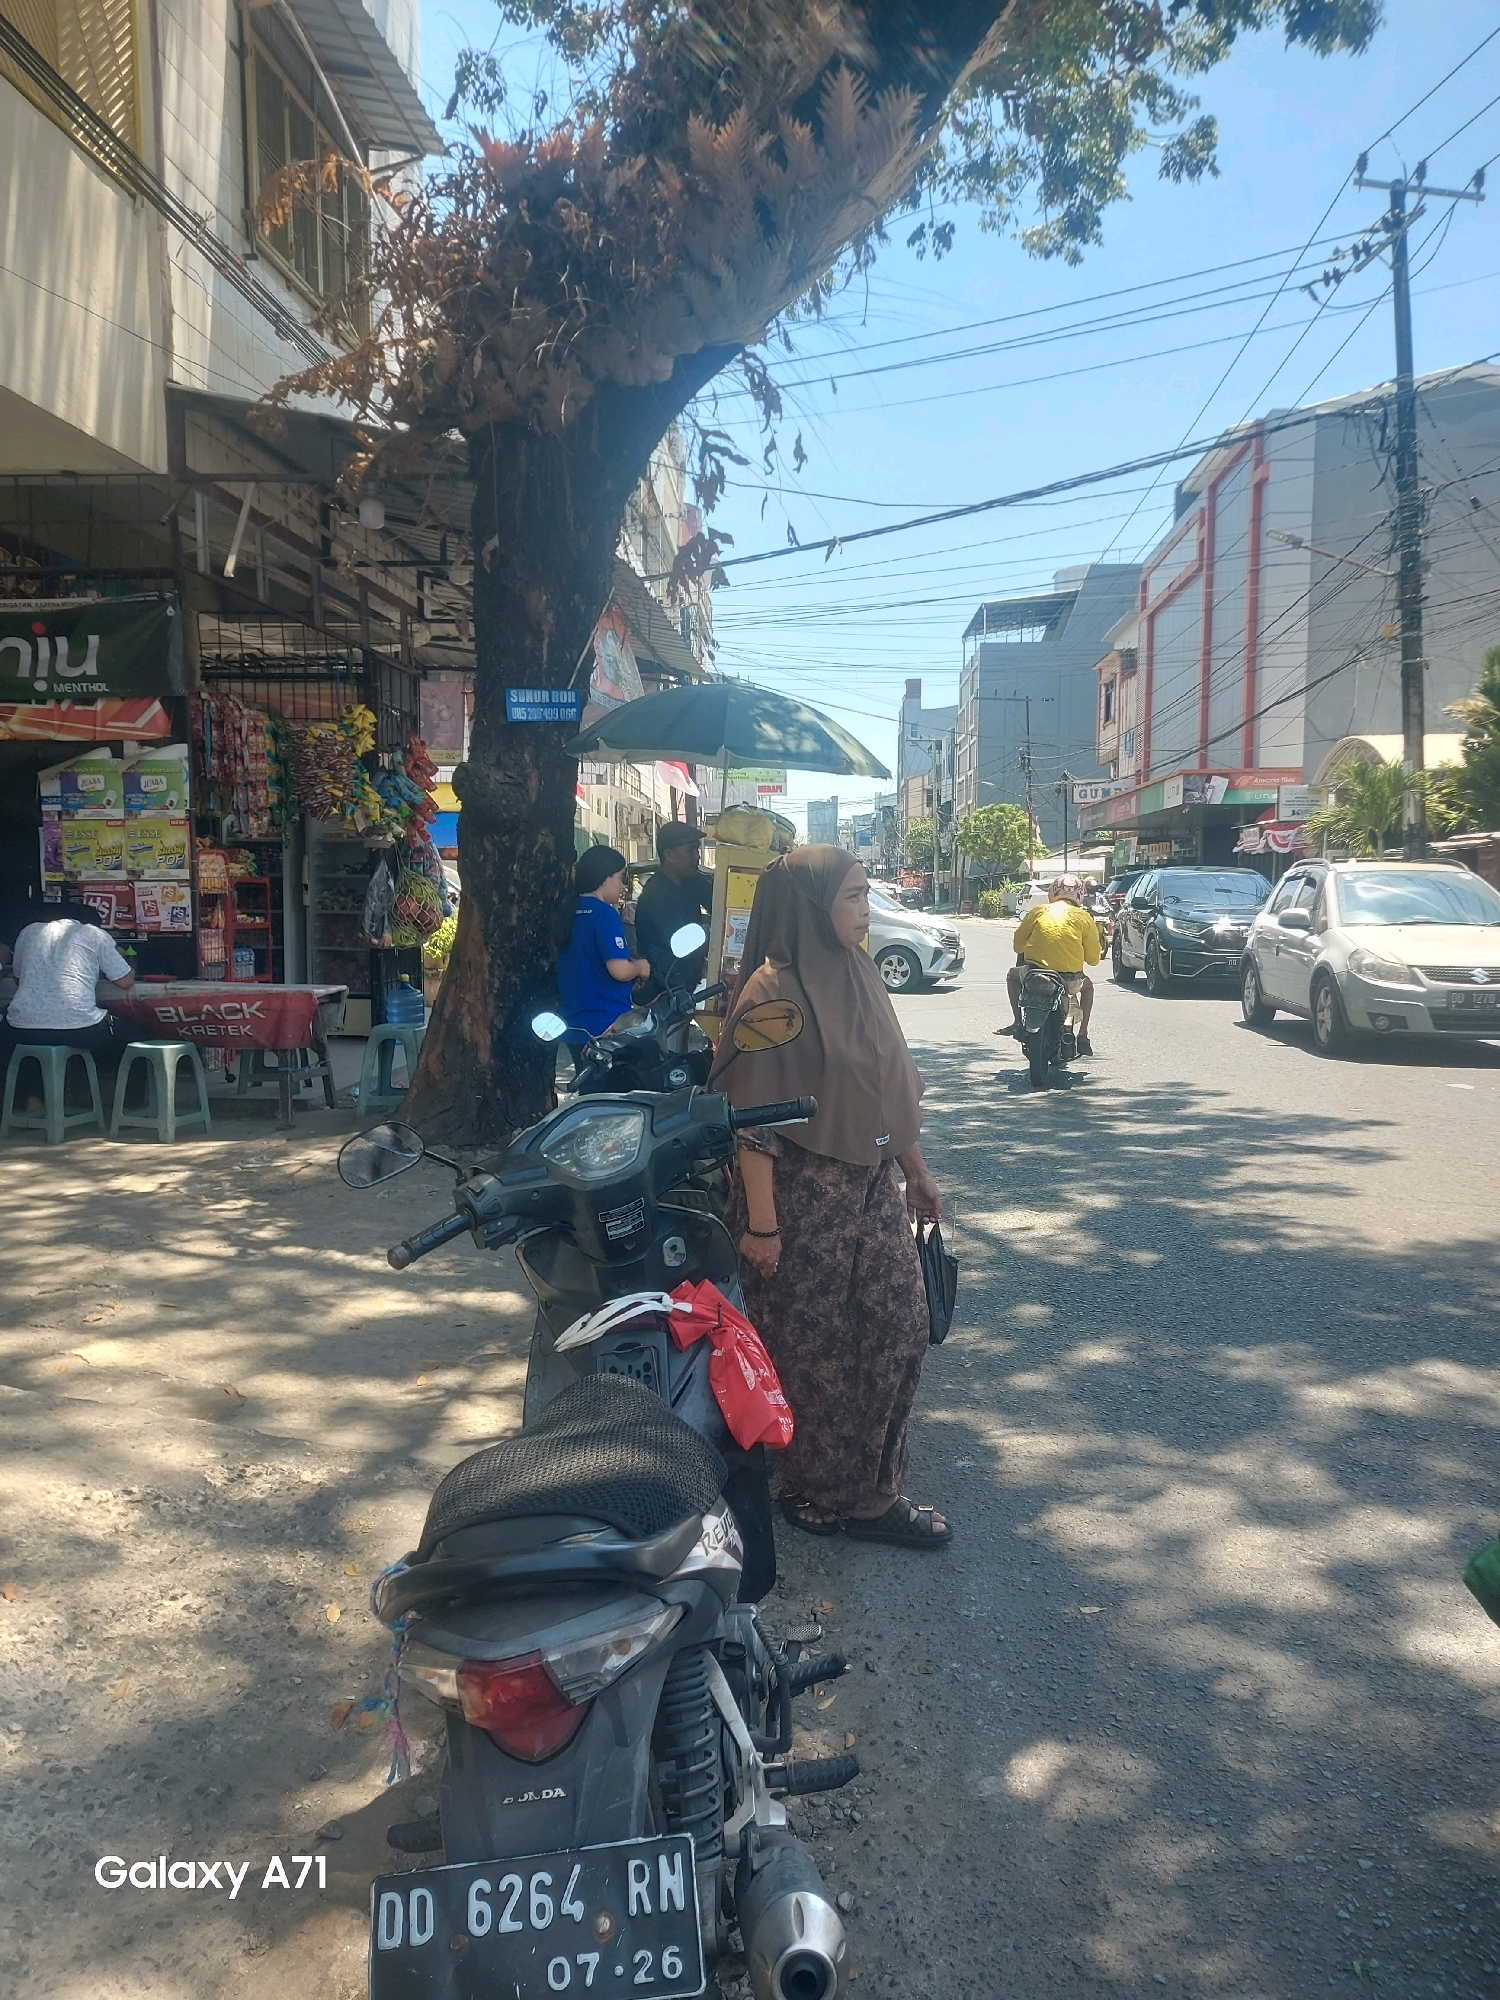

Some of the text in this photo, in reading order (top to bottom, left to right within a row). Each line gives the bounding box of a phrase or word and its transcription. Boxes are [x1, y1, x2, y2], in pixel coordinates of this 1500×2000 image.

[53, 682, 110, 693] MENTHOL
[551, 690, 576, 703] BOR
[74, 829, 98, 839] ESSE
[137, 829, 162, 838] ESSE
[93, 855, 122, 867] POP
[155, 855, 186, 867] POP
[1451, 992, 1465, 1004] DD
[153, 1000, 266, 1023] BLACK
[176, 1024, 253, 1036] KRETEK
[377, 1852, 685, 1950] DD 6264 RN
